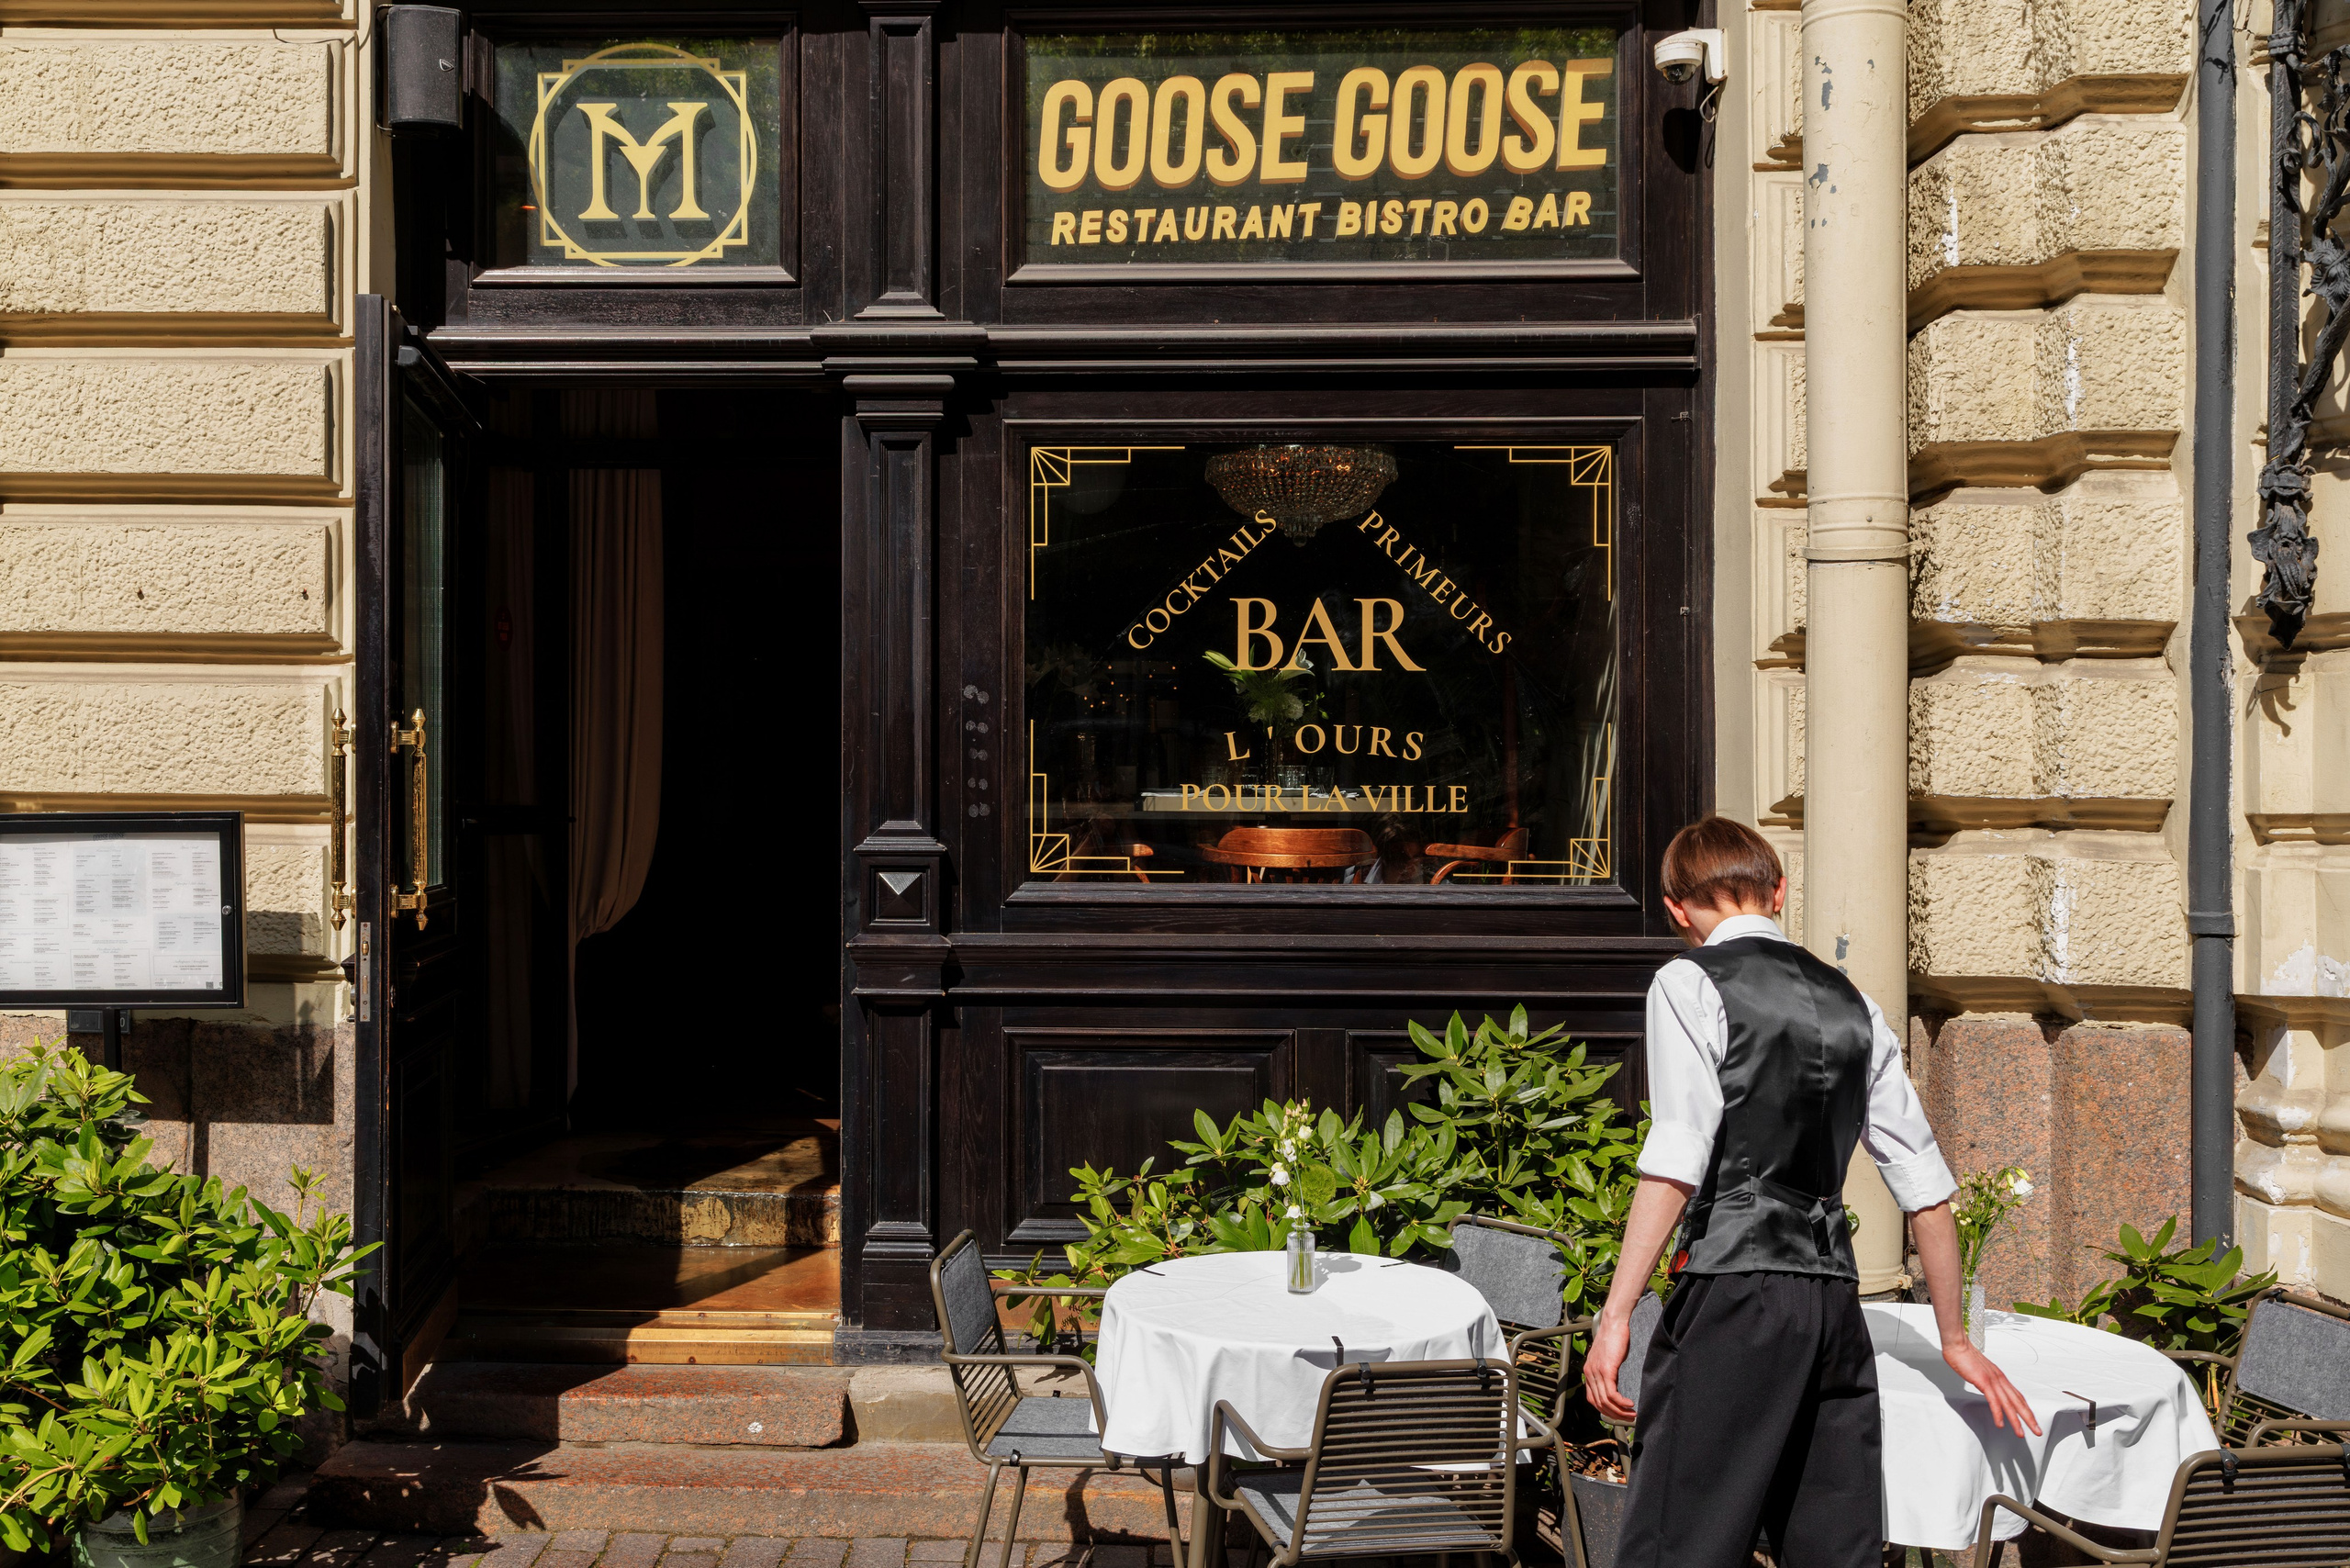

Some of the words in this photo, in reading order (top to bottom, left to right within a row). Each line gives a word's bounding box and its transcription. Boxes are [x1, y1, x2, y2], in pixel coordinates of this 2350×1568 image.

[1038, 71, 1315, 193] GOOSE
[1332, 57, 1614, 181] GOOSE
[1051, 202, 1322, 245] RESTAURANT
[1335, 197, 1489, 240] BISTRO
[1500, 191, 1592, 230] BAR
[1127, 509, 1277, 649] COCKTAILS
[1357, 509, 1513, 655] PRIMEURS
[1228, 597, 1427, 672] BAR
[1180, 783, 1286, 812] POUR
[1301, 784, 1352, 812] LA
[1360, 784, 1469, 813] VILLE
